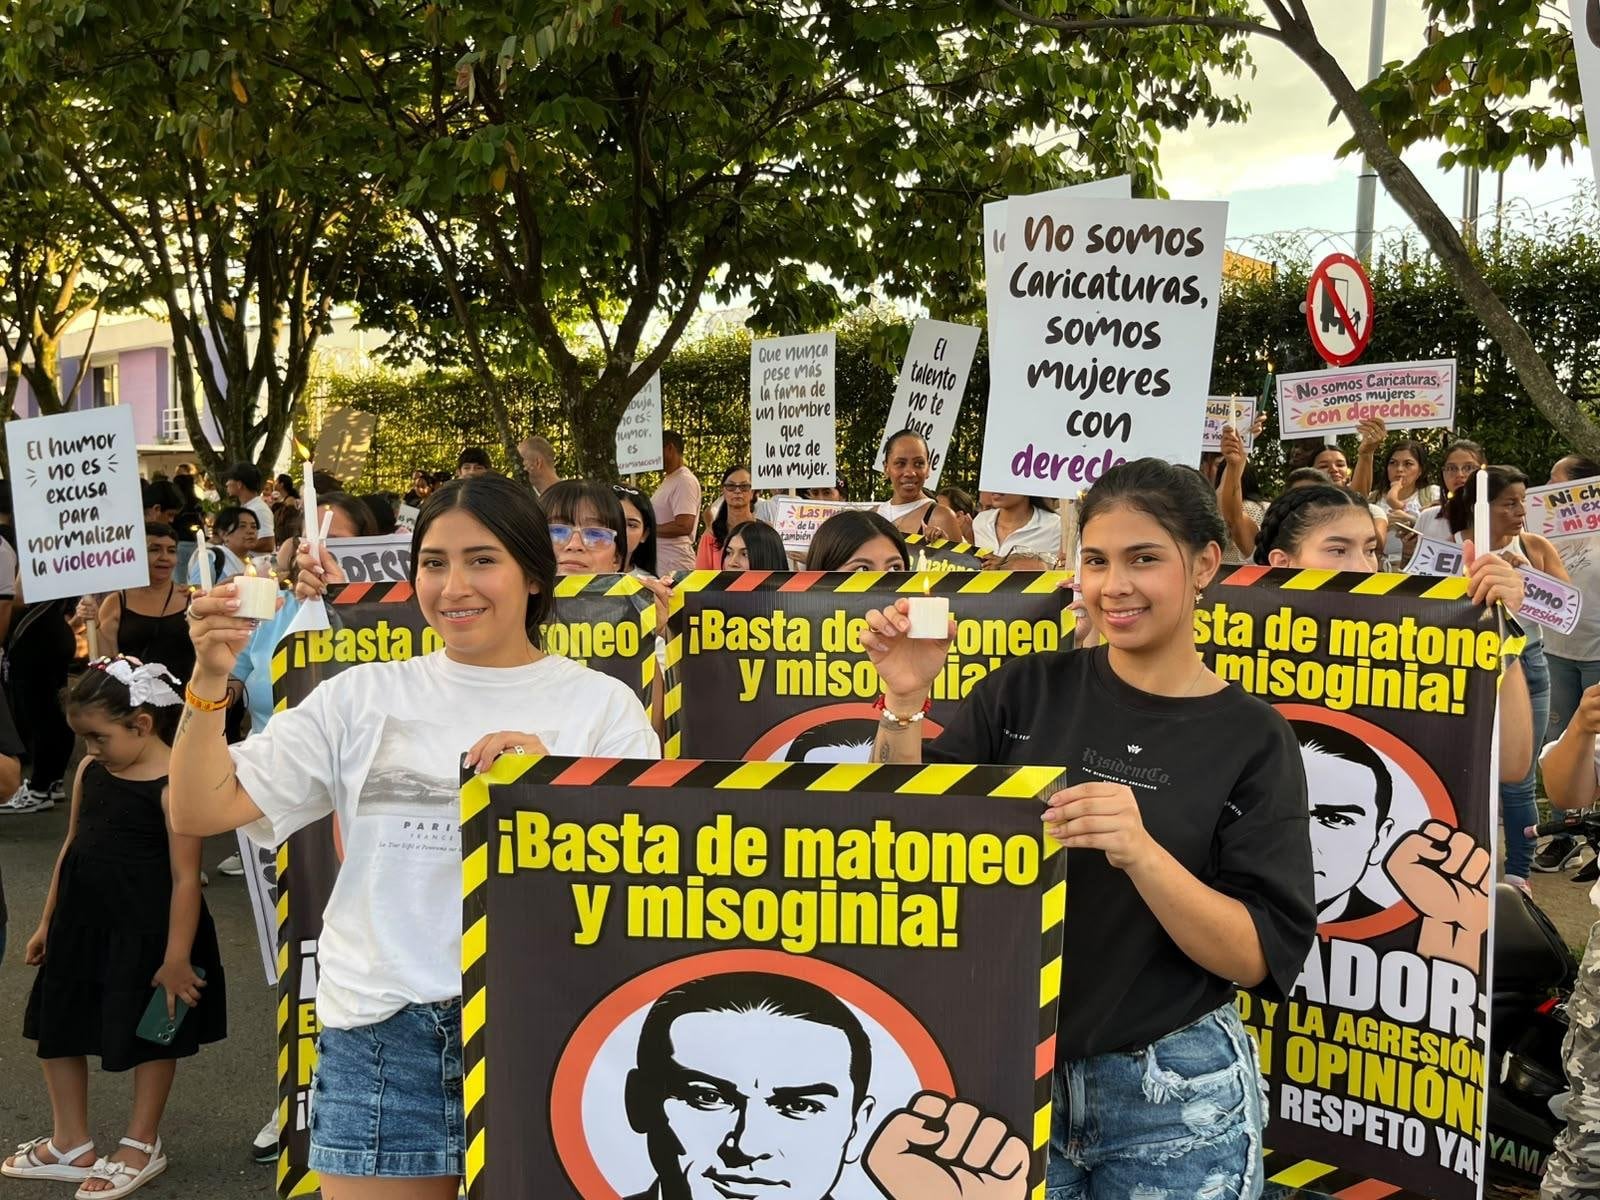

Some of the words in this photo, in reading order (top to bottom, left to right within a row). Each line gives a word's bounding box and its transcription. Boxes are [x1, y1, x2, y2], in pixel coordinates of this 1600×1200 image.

[1024, 214, 1074, 253] No
[1085, 223, 1205, 258] somos
[1009, 261, 1208, 309] Caricaturas,
[1044, 315, 1162, 350] somos
[759, 347, 781, 363] Que
[785, 343, 828, 361] nunca
[934, 337, 947, 361] El
[763, 366, 790, 385] pese
[794, 360, 822, 379] más
[910, 360, 956, 391] talento
[1027, 357, 1171, 400] mujeres
[760, 385, 770, 401] la
[774, 383, 806, 400] fama
[810, 380, 826, 397] de
[1296, 383, 1319, 400] No
[1321, 378, 1363, 395] somos
[1366, 373, 1440, 388] Caricaturas,
[1323, 394, 1362, 407] somos
[1366, 388, 1415, 402] mujeres
[756, 406, 773, 421] un
[778, 401, 831, 419] hombre
[908, 391, 927, 412] no
[930, 394, 944, 417] te
[1307, 409, 1342, 426] con
[1346, 401, 1435, 421] derechos.
[780, 423, 804, 443] que
[1066, 409, 1132, 443] con
[27, 440, 43, 461] El
[48, 433, 117, 458] humor
[766, 442, 775, 458] la
[779, 444, 801, 458] voz
[805, 440, 821, 456] de
[48, 461, 75, 481] no
[81, 457, 101, 475] es
[758, 463, 783, 477] una
[786, 459, 830, 479] mujer.
[46, 481, 108, 504] excusa
[1548, 489, 1573, 507] Ni
[59, 506, 100, 530] para
[800, 506, 820, 518] Las
[1560, 504, 1577, 517] ni
[1563, 515, 1583, 531] ni
[28, 523, 135, 553] normalizar
[797, 521, 807, 530] de
[32, 557, 47, 577] la
[53, 546, 136, 574] violencia
[1518, 604, 1563, 626] presión
[688, 610, 811, 655] ¡Basta
[1265, 607, 1318, 653] de
[1329, 618, 1501, 670] matone
[739, 659, 765, 702] y
[1216, 651, 1467, 715] misoginia!
[498, 811, 680, 874] ¡Basta
[696, 815, 767, 878] de
[784, 820, 1039, 886] matoneo
[572, 883, 610, 944] y
[627, 876, 957, 953] misoginia!
[1261, 999, 1279, 1027] Y
[1288, 1001, 1325, 1039] LA
[1334, 1014, 1485, 1087] AGRESIÓN
[1280, 1083, 1425, 1157] RESPETO
